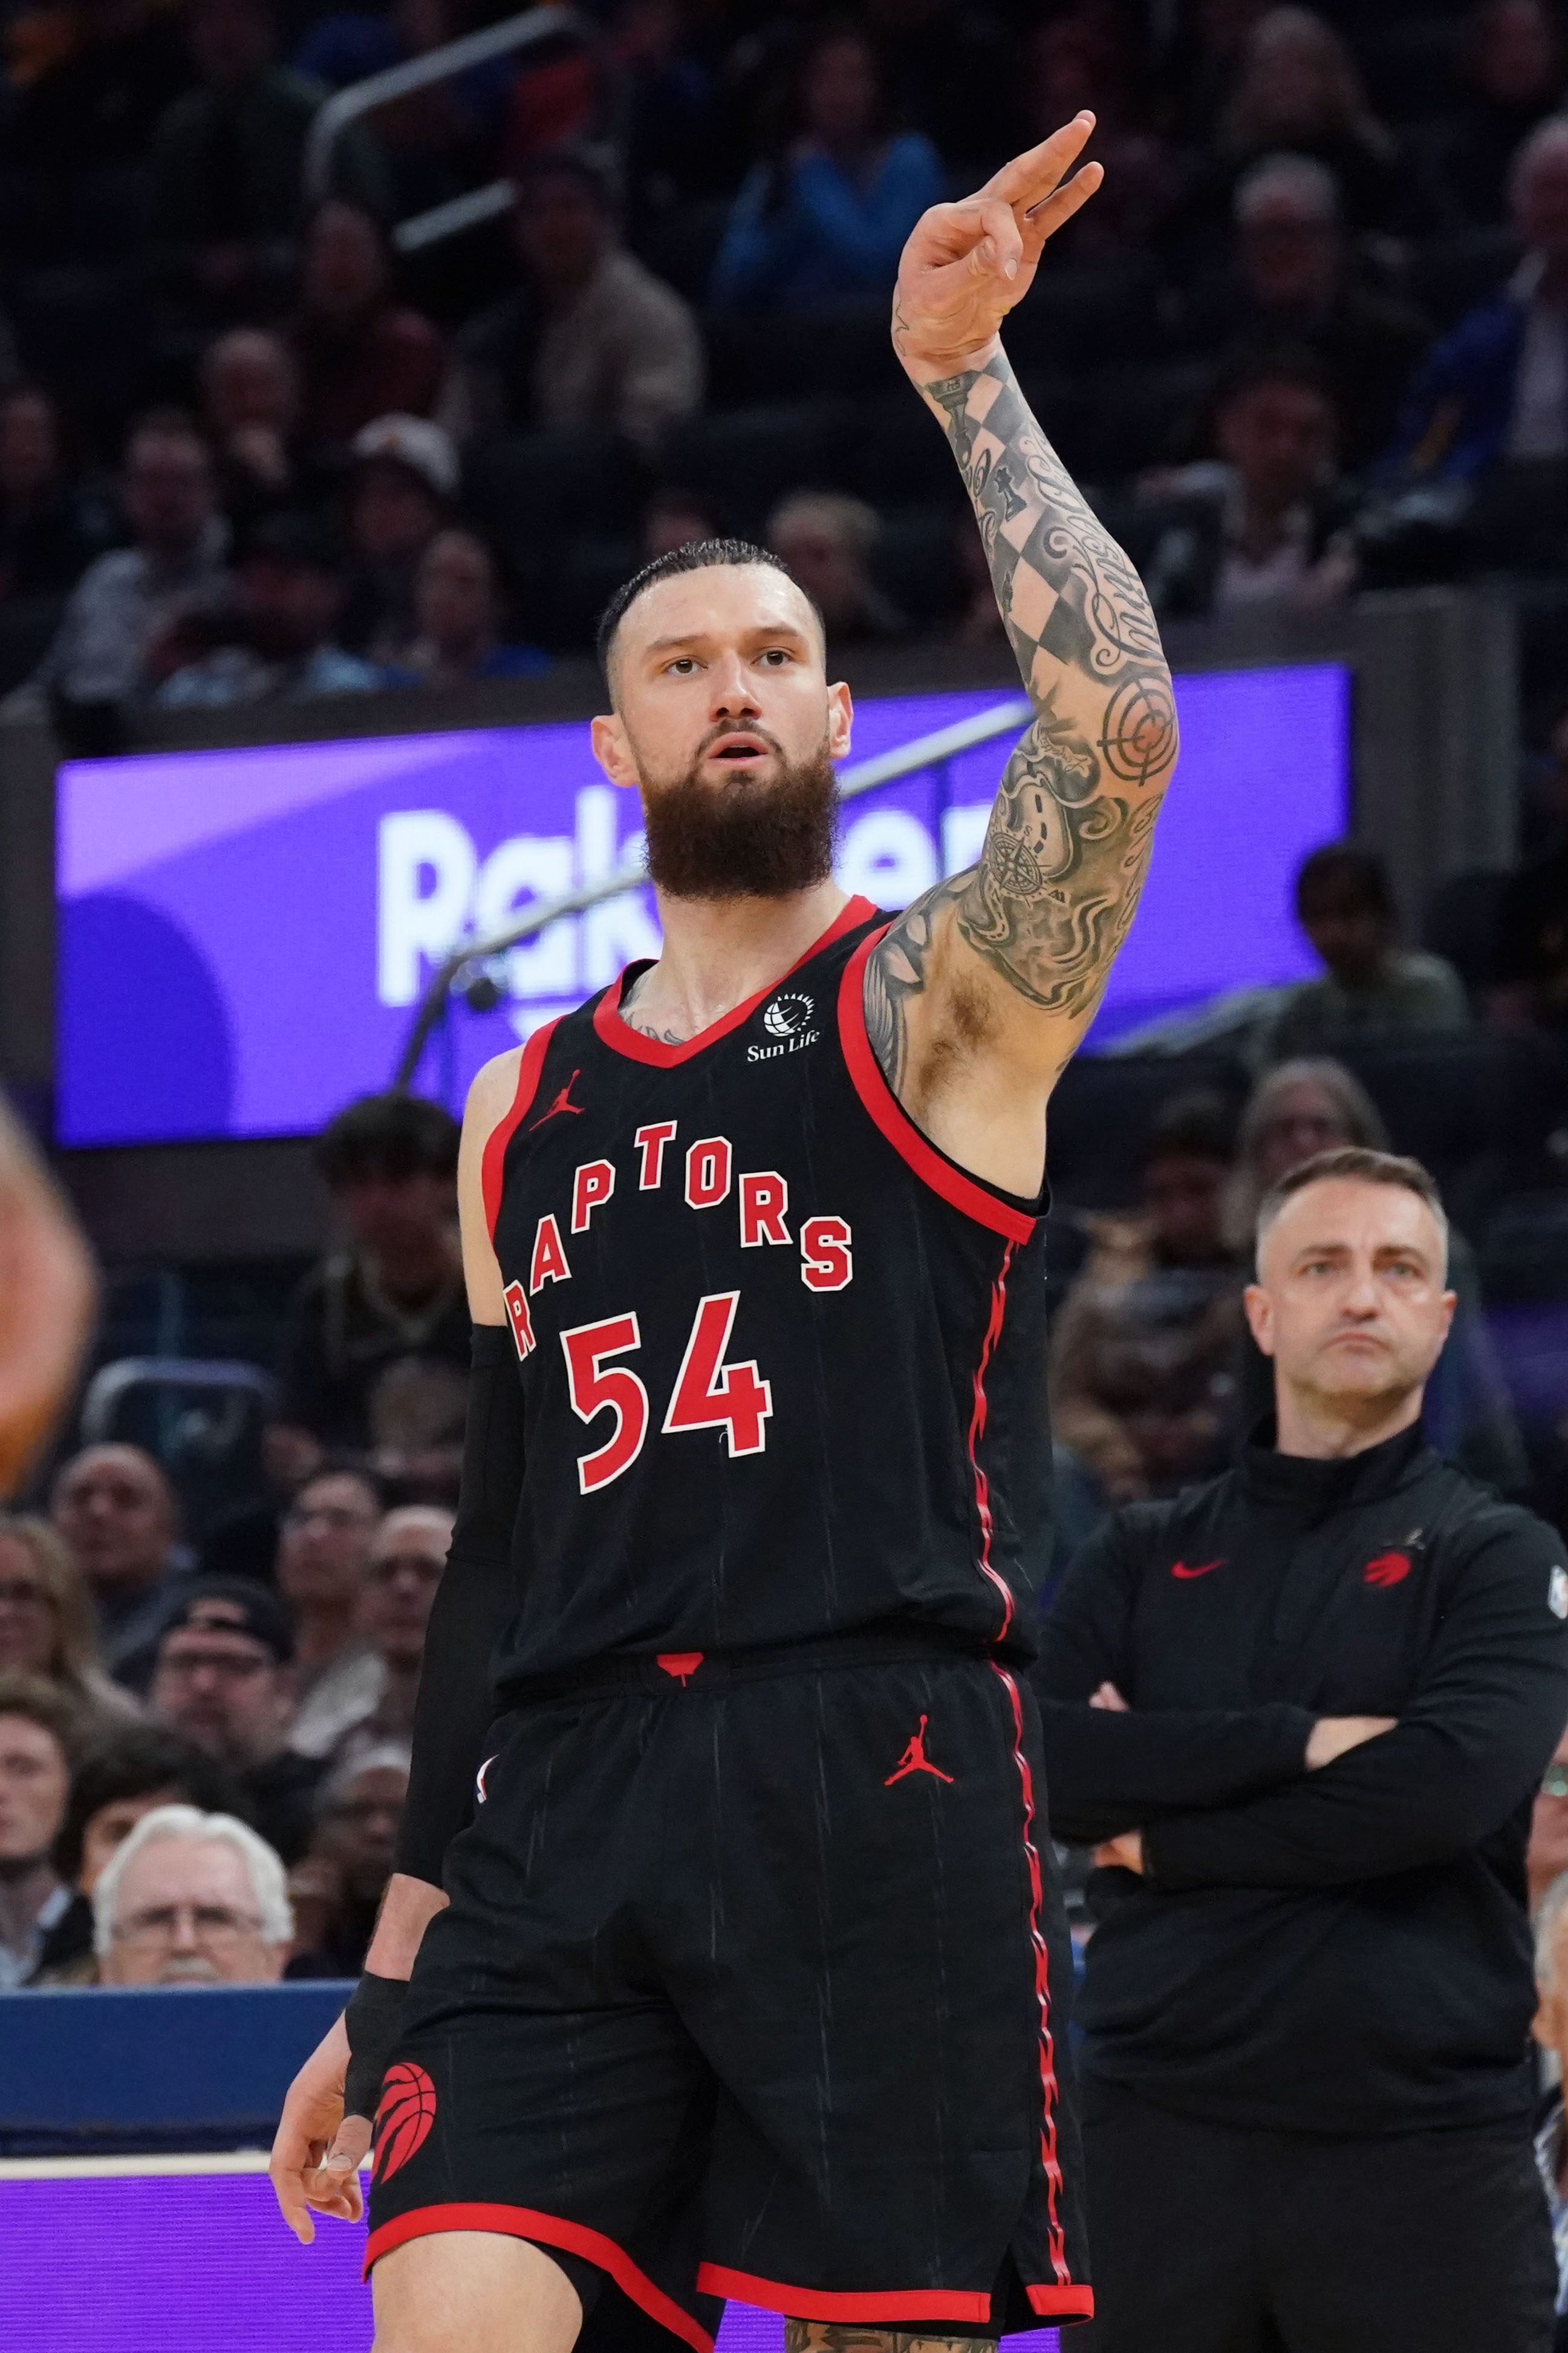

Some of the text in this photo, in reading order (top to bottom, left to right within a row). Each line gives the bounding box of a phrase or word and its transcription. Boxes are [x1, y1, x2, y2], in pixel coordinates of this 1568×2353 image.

[747, 1029, 820, 1062] Sun Life
[503, 1120, 853, 1362] RAPTORS
[559, 1290, 773, 1495] 54
